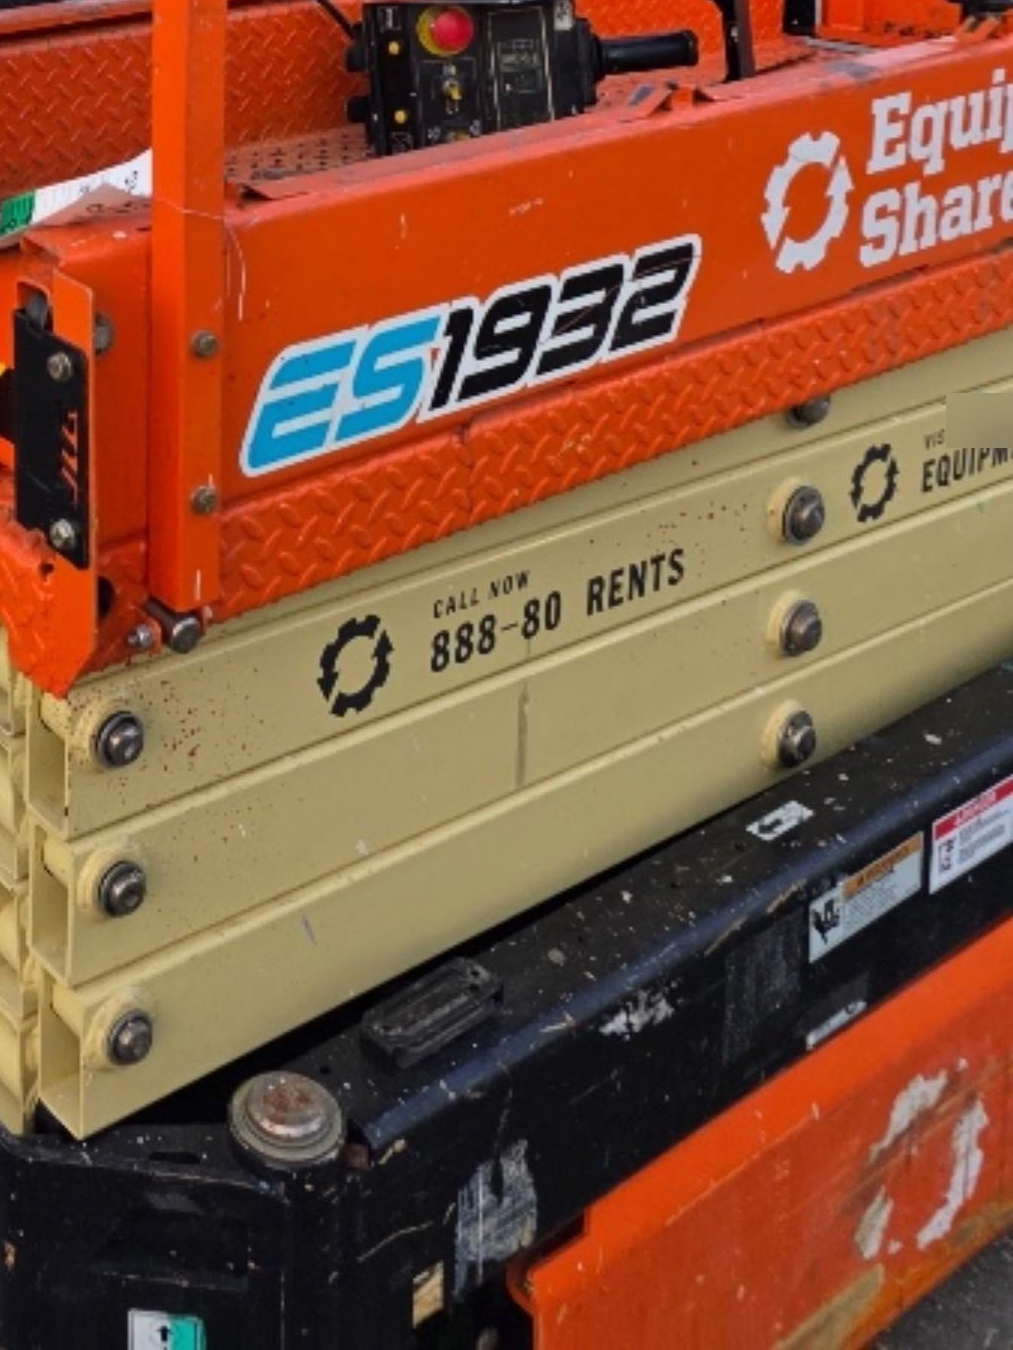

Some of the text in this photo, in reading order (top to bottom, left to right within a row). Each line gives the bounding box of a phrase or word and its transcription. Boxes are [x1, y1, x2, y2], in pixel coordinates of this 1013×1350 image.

[241, 236, 701, 477] ES1932
[921, 447, 1013, 493] EQUIPM
[430, 548, 685, 673] 888-80 RENTS
[433, 569, 531, 619] CALL NOW
